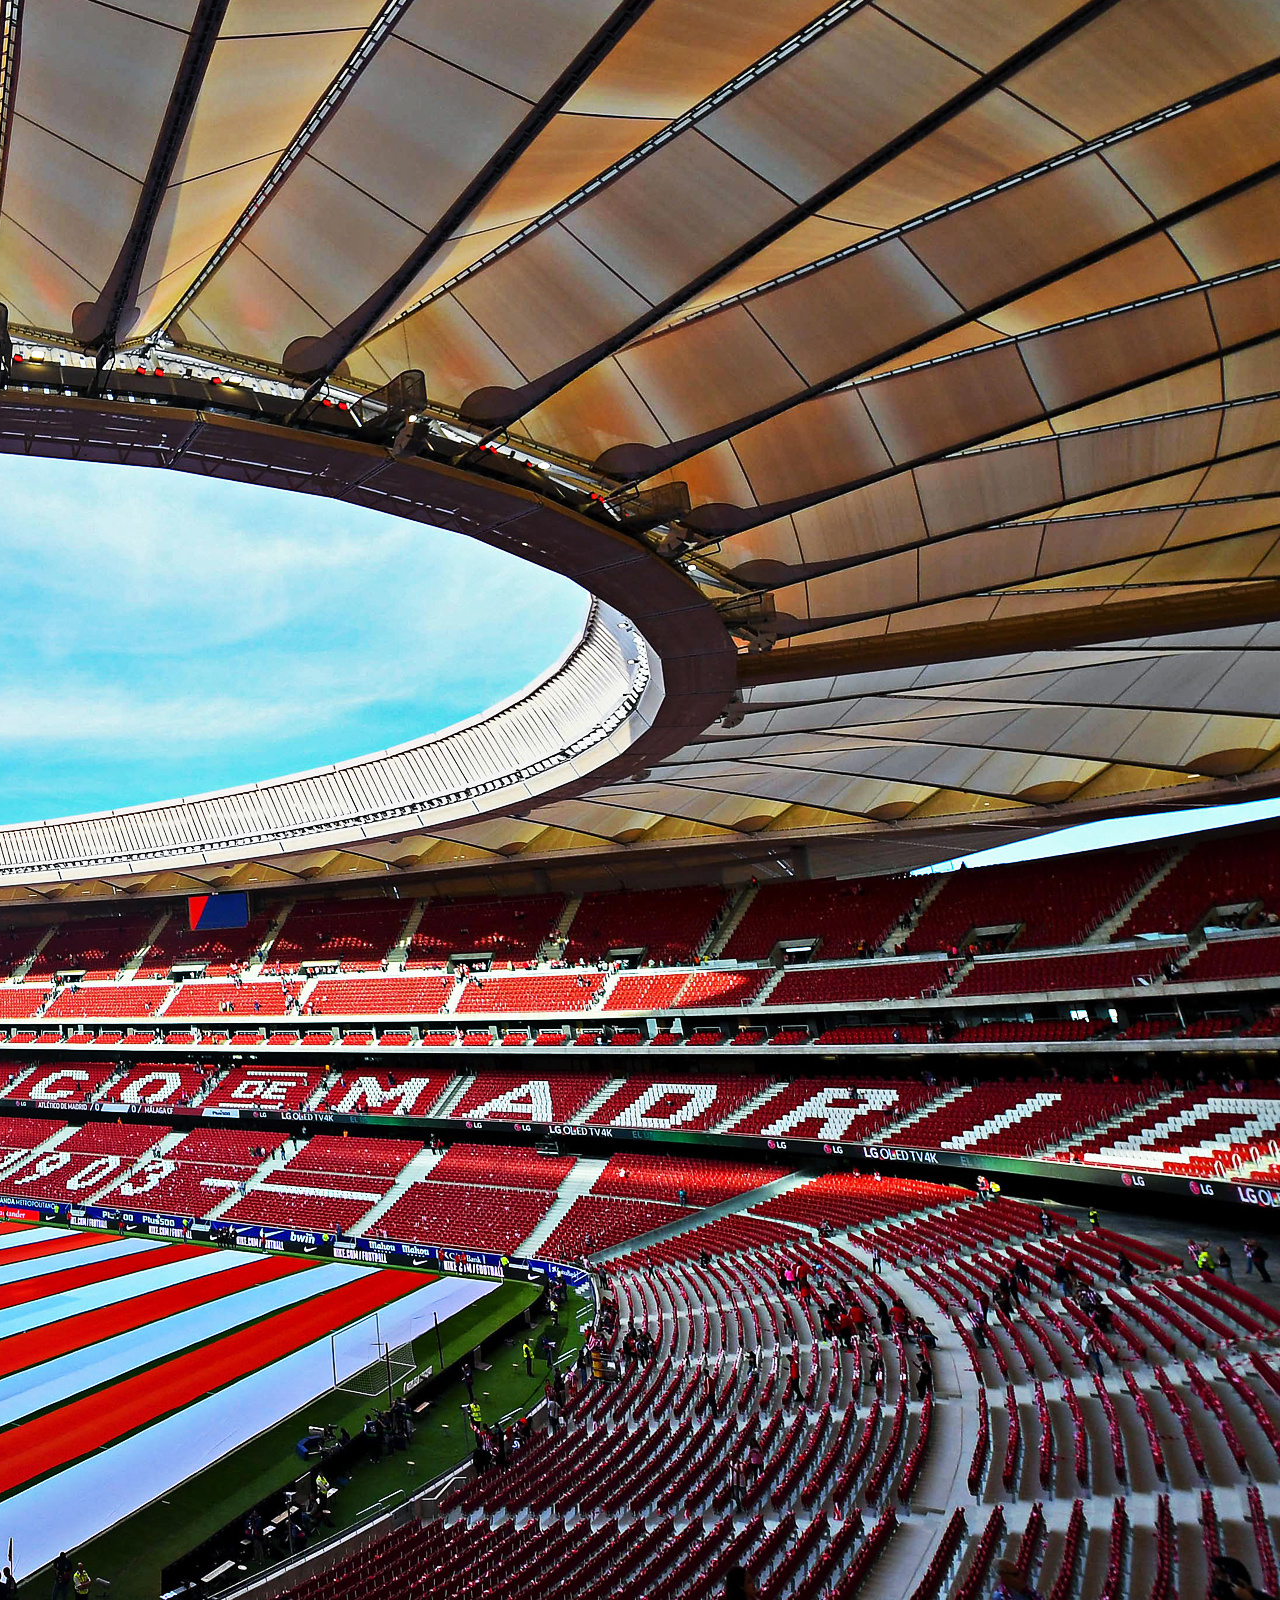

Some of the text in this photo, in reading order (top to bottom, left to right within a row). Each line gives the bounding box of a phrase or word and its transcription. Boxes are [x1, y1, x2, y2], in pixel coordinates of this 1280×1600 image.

[230, 1080, 296, 1101] DE
[549, 1126, 562, 1134] LG
[563, 1127, 588, 1136] OLED
[776, 1141, 787, 1149] LG
[832, 1146, 843, 1154] LG
[863, 1146, 879, 1159] LG
[880, 1148, 909, 1161] OLED
[1131, 1175, 1146, 1188] LG
[1199, 1184, 1214, 1196] LG
[1237, 1186, 1258, 1204] LG
[16, 1199, 57, 1210] METROPOLITANO
[143, 1215, 175, 1226] Plus500
[290, 1231, 316, 1245] bwin
[369, 1240, 396, 1252] Mahou
[402, 1244, 430, 1256] Mahou
